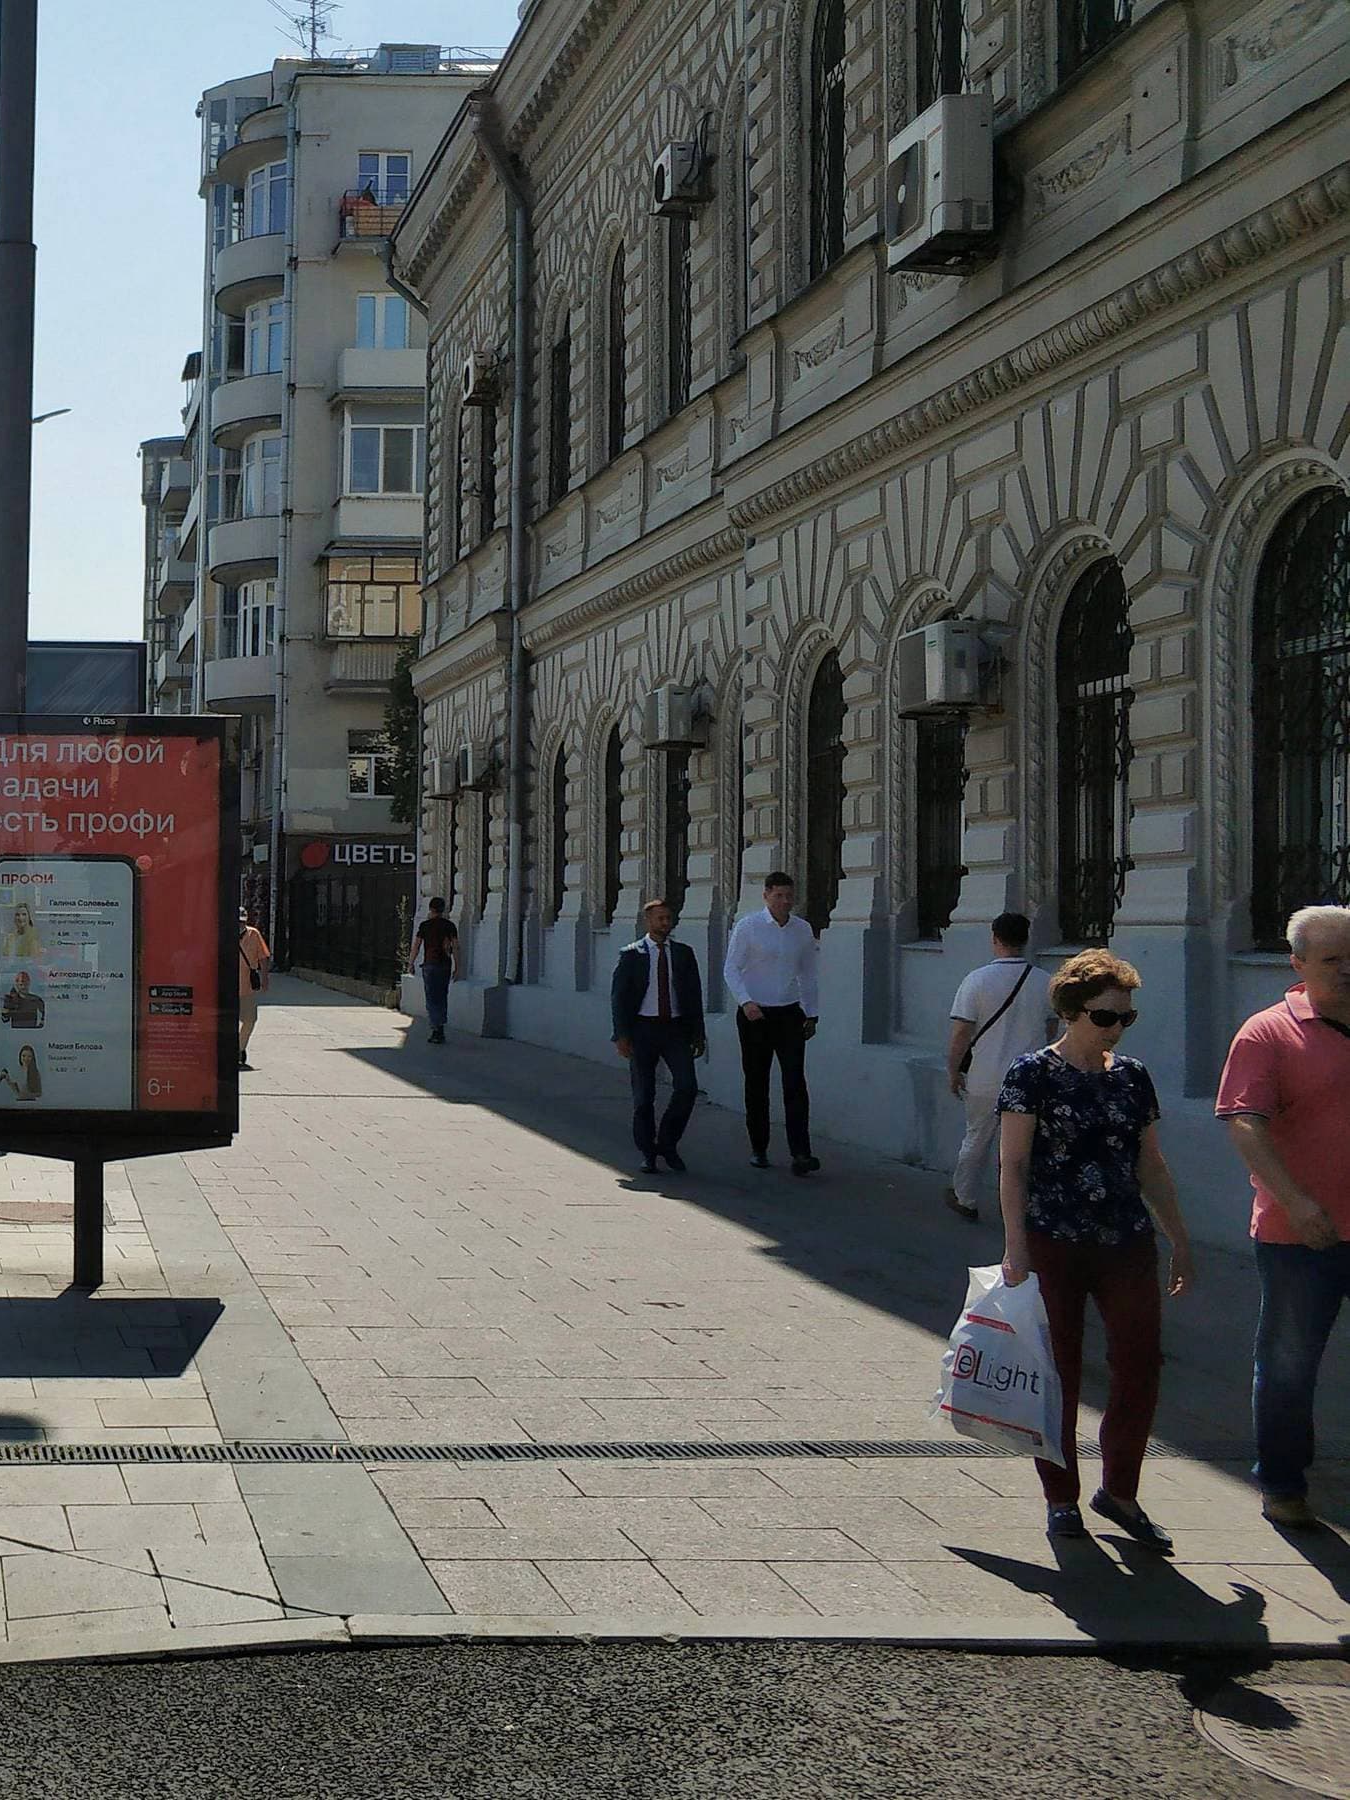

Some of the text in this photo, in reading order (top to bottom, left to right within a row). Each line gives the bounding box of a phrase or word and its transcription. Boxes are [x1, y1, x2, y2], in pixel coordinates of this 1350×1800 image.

[93, 716, 116, 725] Russ
[56, 737, 164, 763] любой
[68, 808, 175, 839] профи
[1, 873, 54, 885] ПРОФИ
[147, 1078, 175, 1096] 6+
